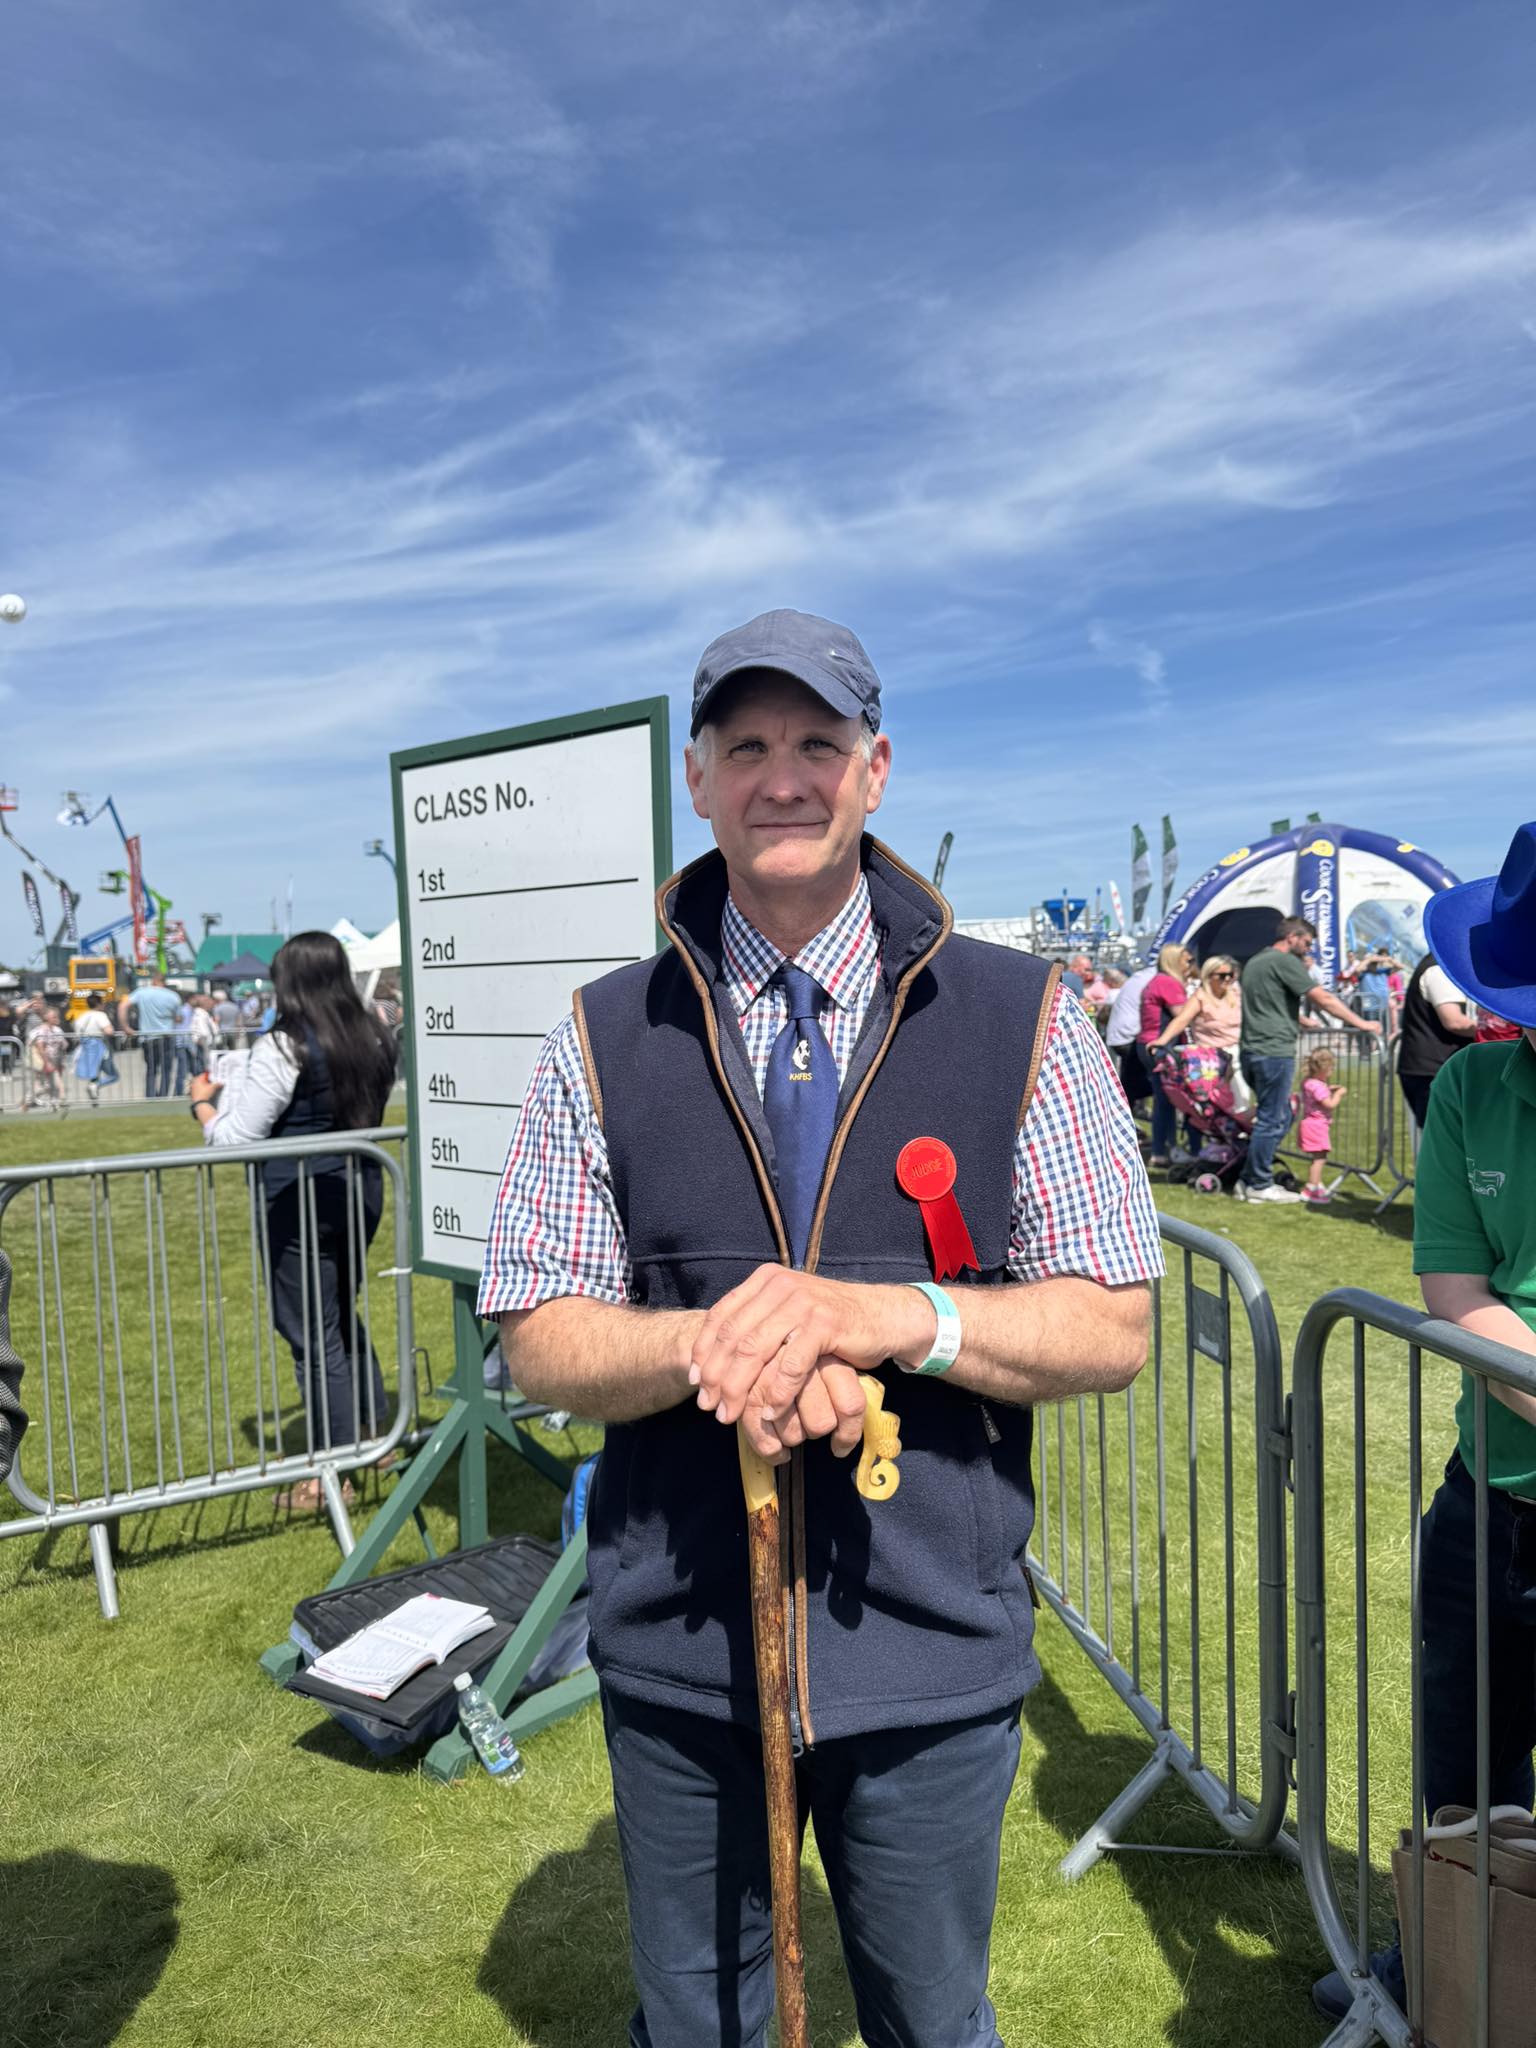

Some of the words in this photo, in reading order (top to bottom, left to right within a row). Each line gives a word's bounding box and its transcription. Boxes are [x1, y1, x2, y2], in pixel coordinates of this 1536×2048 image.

[414, 785, 487, 824] CLASS
[495, 780, 534, 812] No.
[418, 867, 446, 893] 1st
[421, 935, 456, 961] 2nd
[425, 1004, 455, 1030] 3rd
[428, 1072, 457, 1099] 4th
[431, 1136, 460, 1163] 5th
[432, 1204, 462, 1233] 6th
